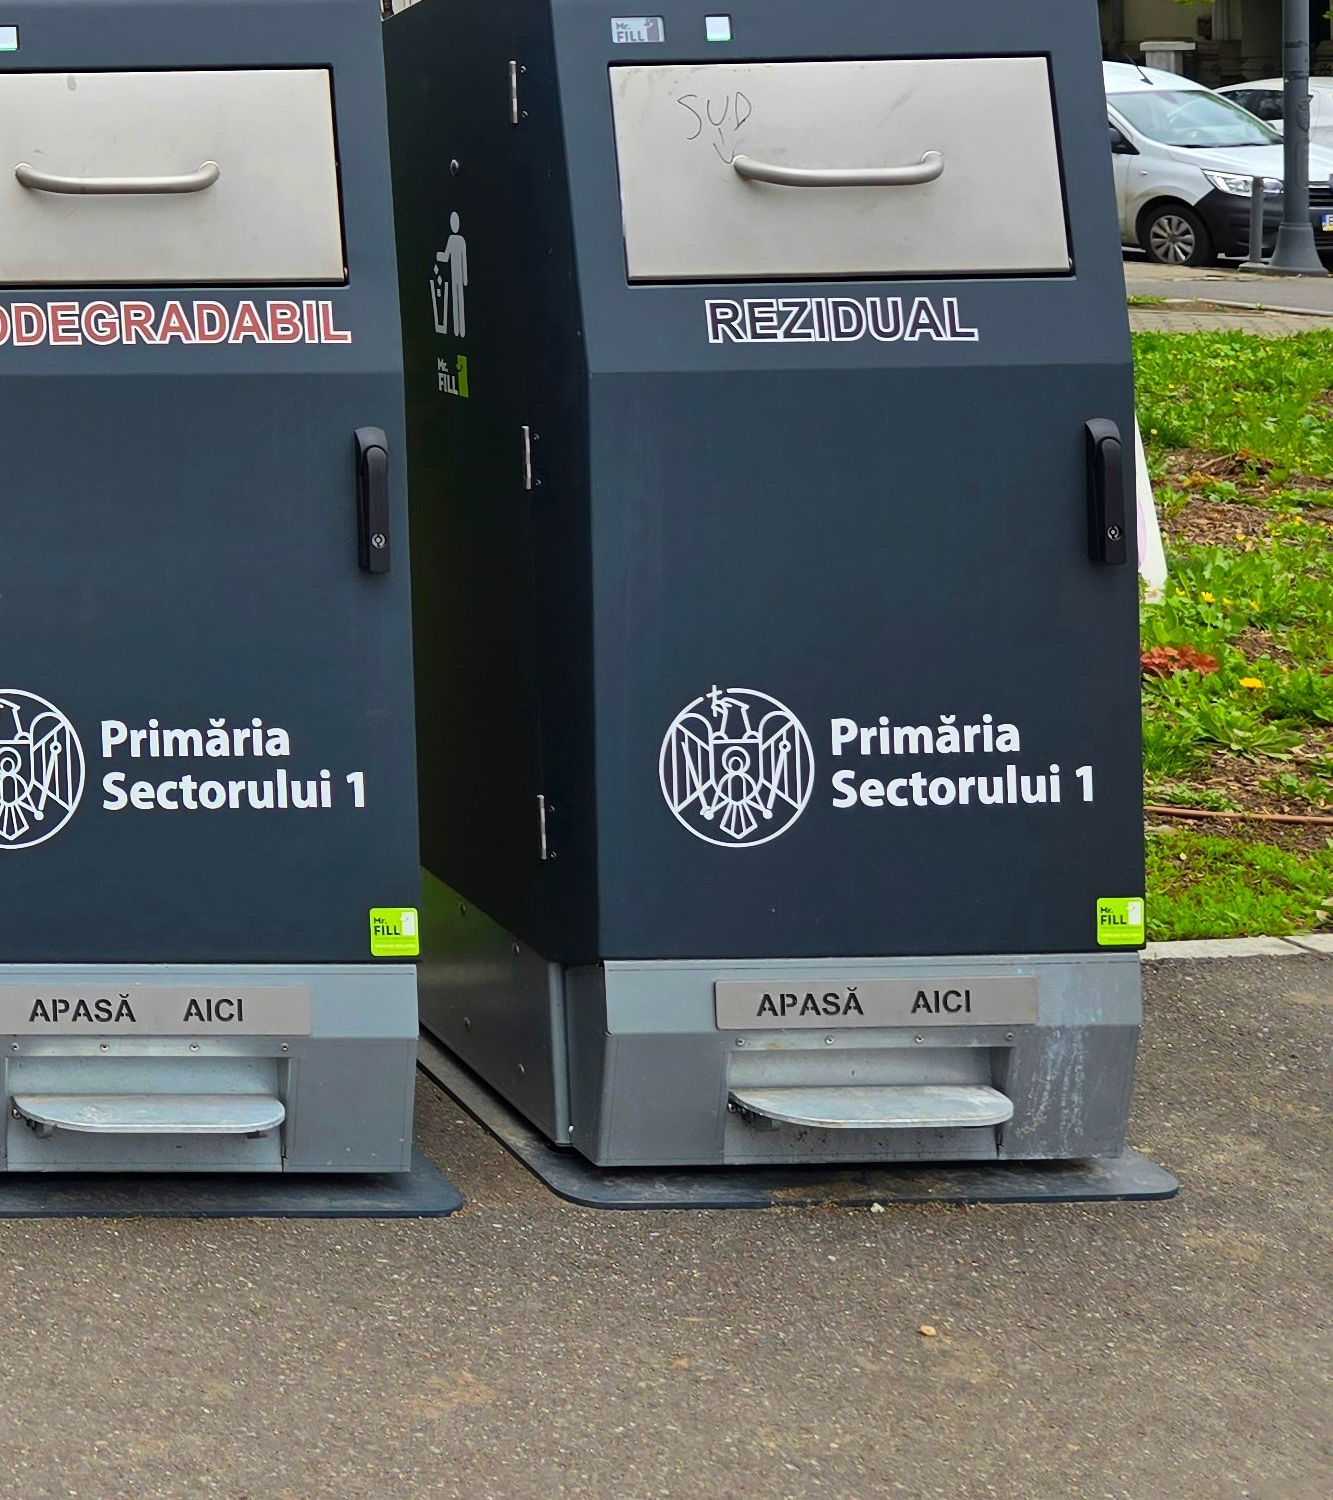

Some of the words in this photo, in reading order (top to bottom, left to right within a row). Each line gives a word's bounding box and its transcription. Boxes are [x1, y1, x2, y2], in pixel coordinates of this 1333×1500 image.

[617, 31, 645, 42] FILL
[705, 297, 980, 344] REZIDUAL
[438, 372, 459, 395] FILL
[101, 717, 291, 757] Primăria
[831, 713, 1021, 756] Primăria
[102, 768, 332, 810] Sectorului
[346, 771, 365, 808] 1
[831, 763, 1061, 808] Sectorului
[1075, 765, 1094, 802] 1
[374, 925, 400, 936] FILL
[1100, 914, 1127, 925] FILL
[28, 994, 137, 1023] APASĂ
[183, 999, 244, 1023] AICI
[756, 987, 864, 1017] APASĂ
[911, 990, 971, 1014] AICI
